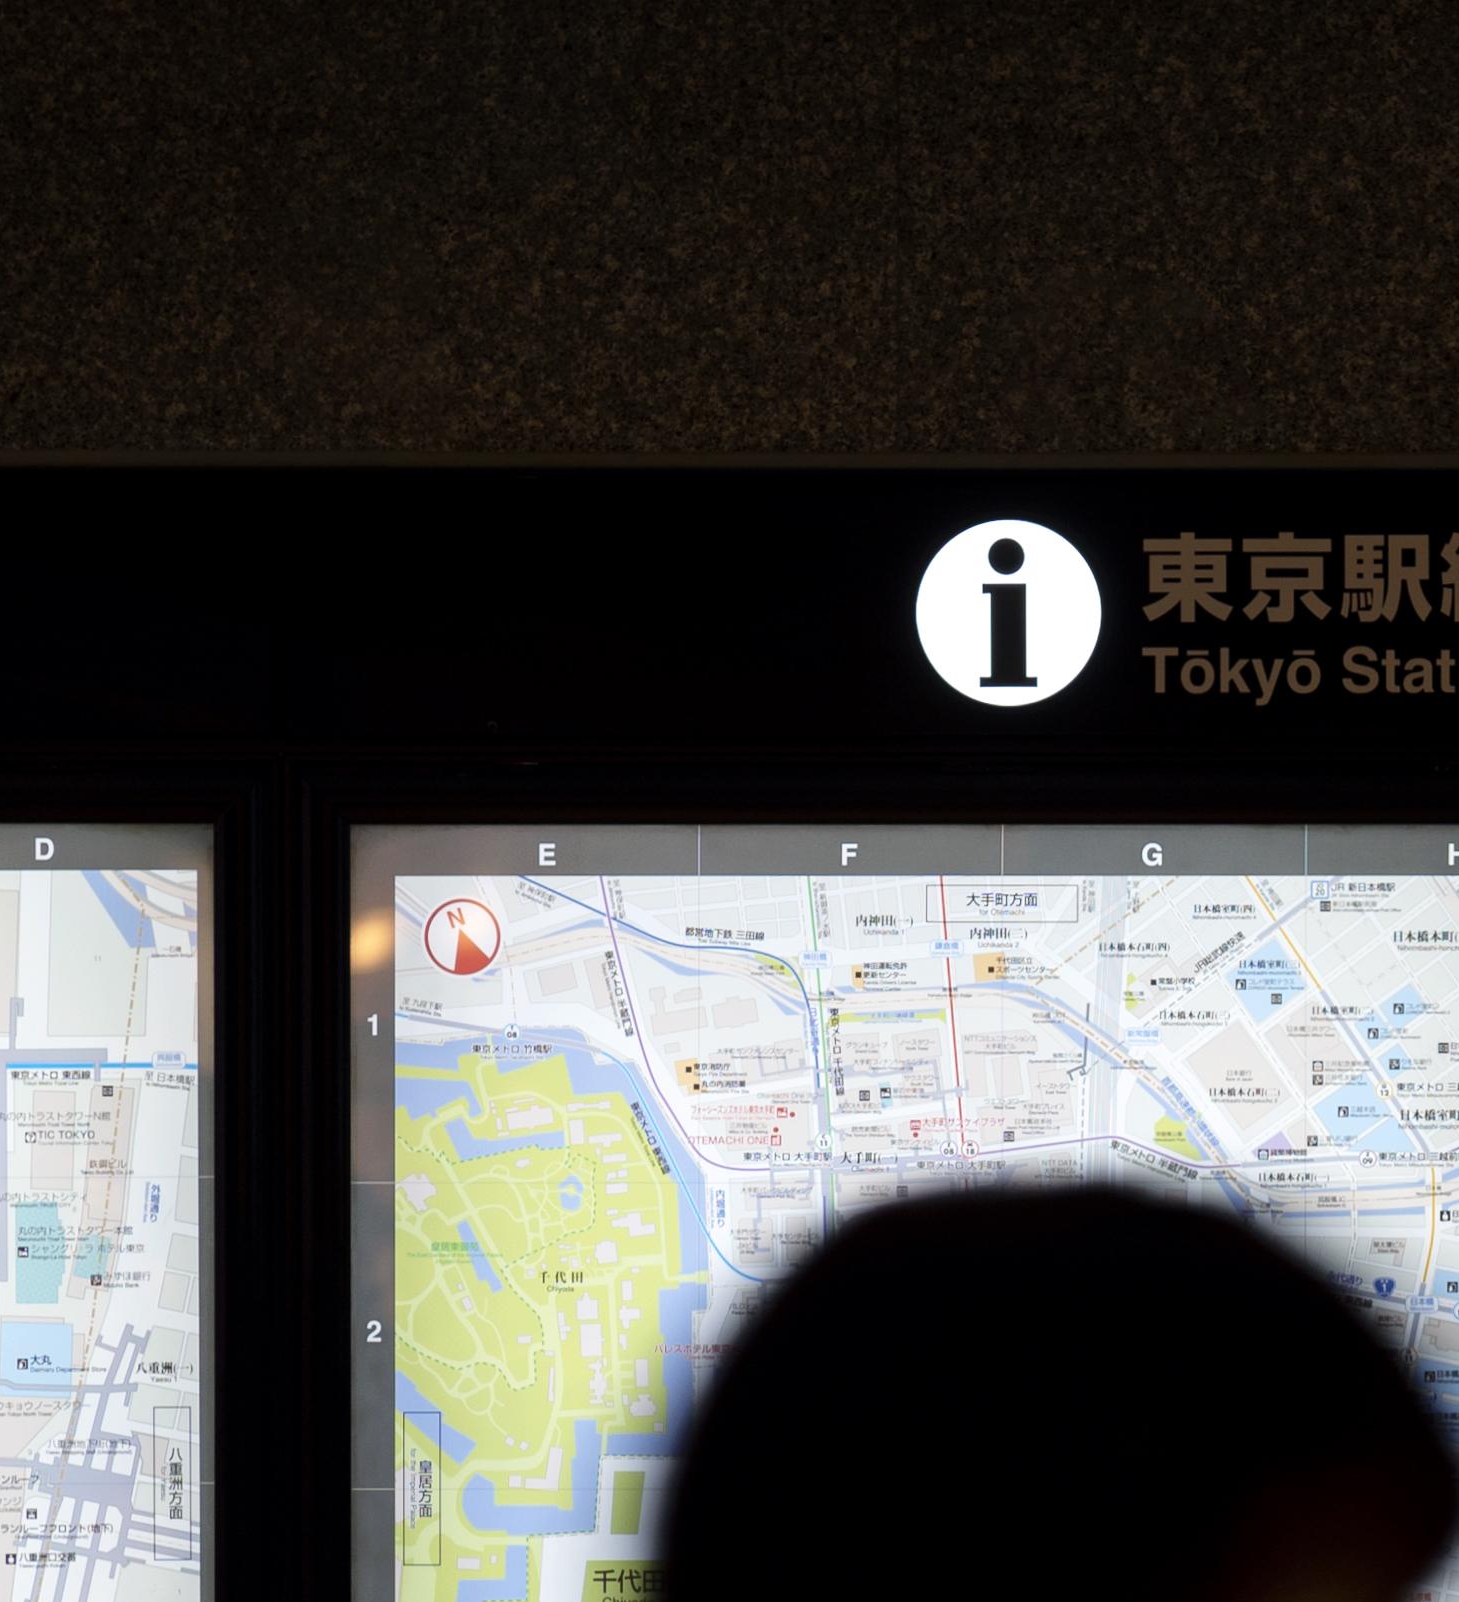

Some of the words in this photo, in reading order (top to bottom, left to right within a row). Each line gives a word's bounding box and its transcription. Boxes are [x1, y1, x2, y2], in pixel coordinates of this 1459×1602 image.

[1141, 646, 1322, 707] Tōkyō
[34, 837, 55, 861] D
[538, 842, 557, 867] E
[841, 843, 859, 867] F
[1141, 842, 1163, 867] G
[367, 1013, 378, 1037] 1
[366, 1319, 382, 1343] 2
[416, 1457, 436, 1519] 皇居方面
